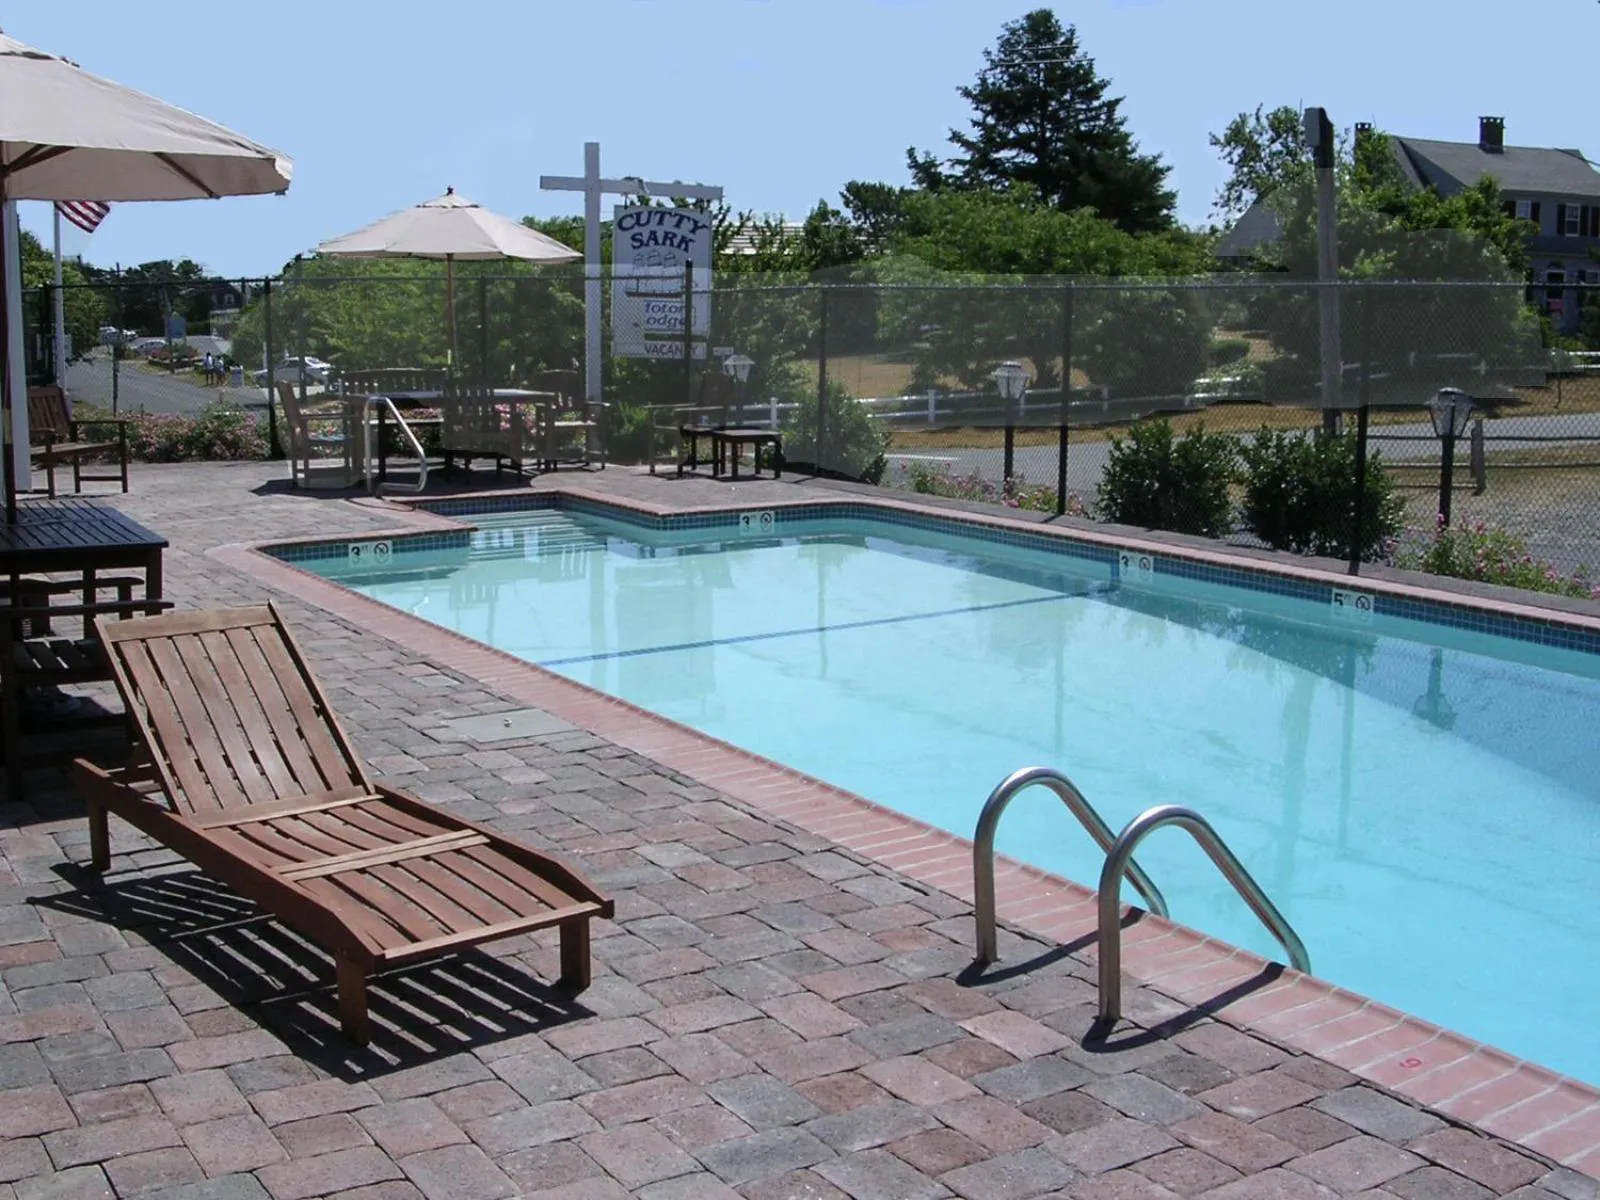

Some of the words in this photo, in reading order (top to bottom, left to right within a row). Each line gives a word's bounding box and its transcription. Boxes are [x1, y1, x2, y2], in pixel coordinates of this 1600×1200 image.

[617, 210, 709, 235] CUTTY
[629, 230, 697, 253] SARK
[644, 342, 699, 354] VACANY
